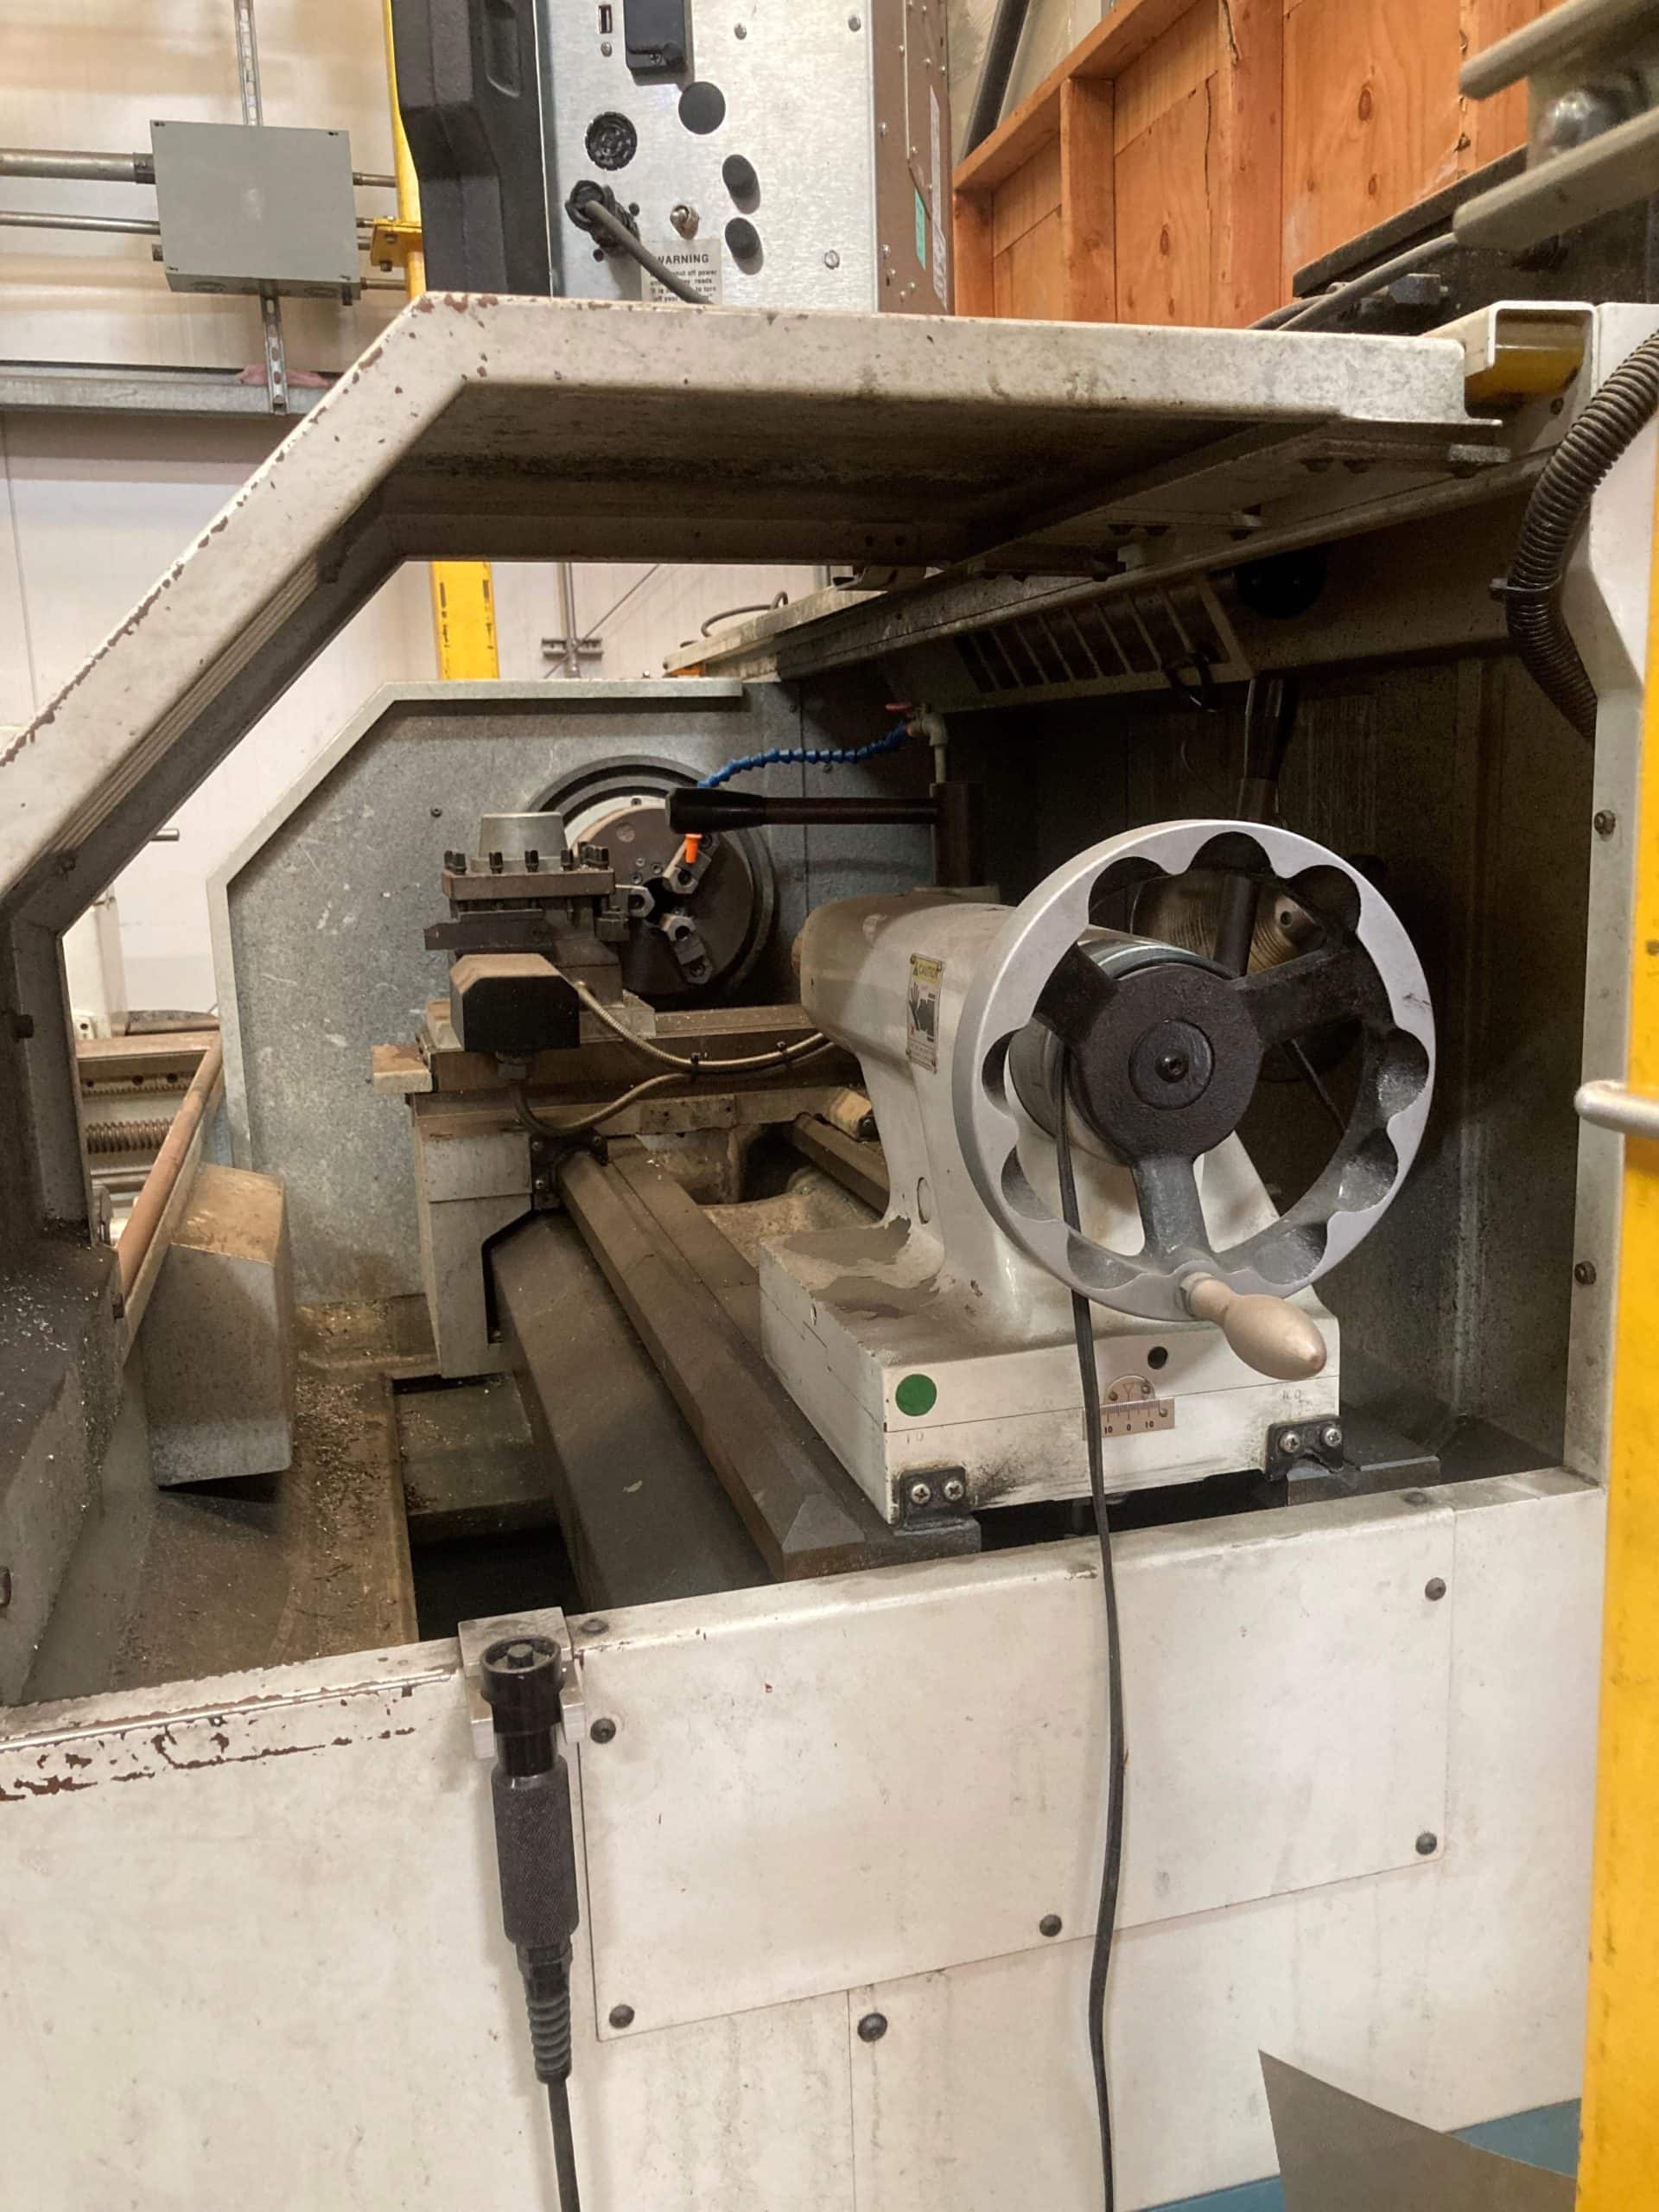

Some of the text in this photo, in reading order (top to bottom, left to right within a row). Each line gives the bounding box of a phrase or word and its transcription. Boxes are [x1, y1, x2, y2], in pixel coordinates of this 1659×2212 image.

[1104, 1421, 1154, 1434] 10 0 10
